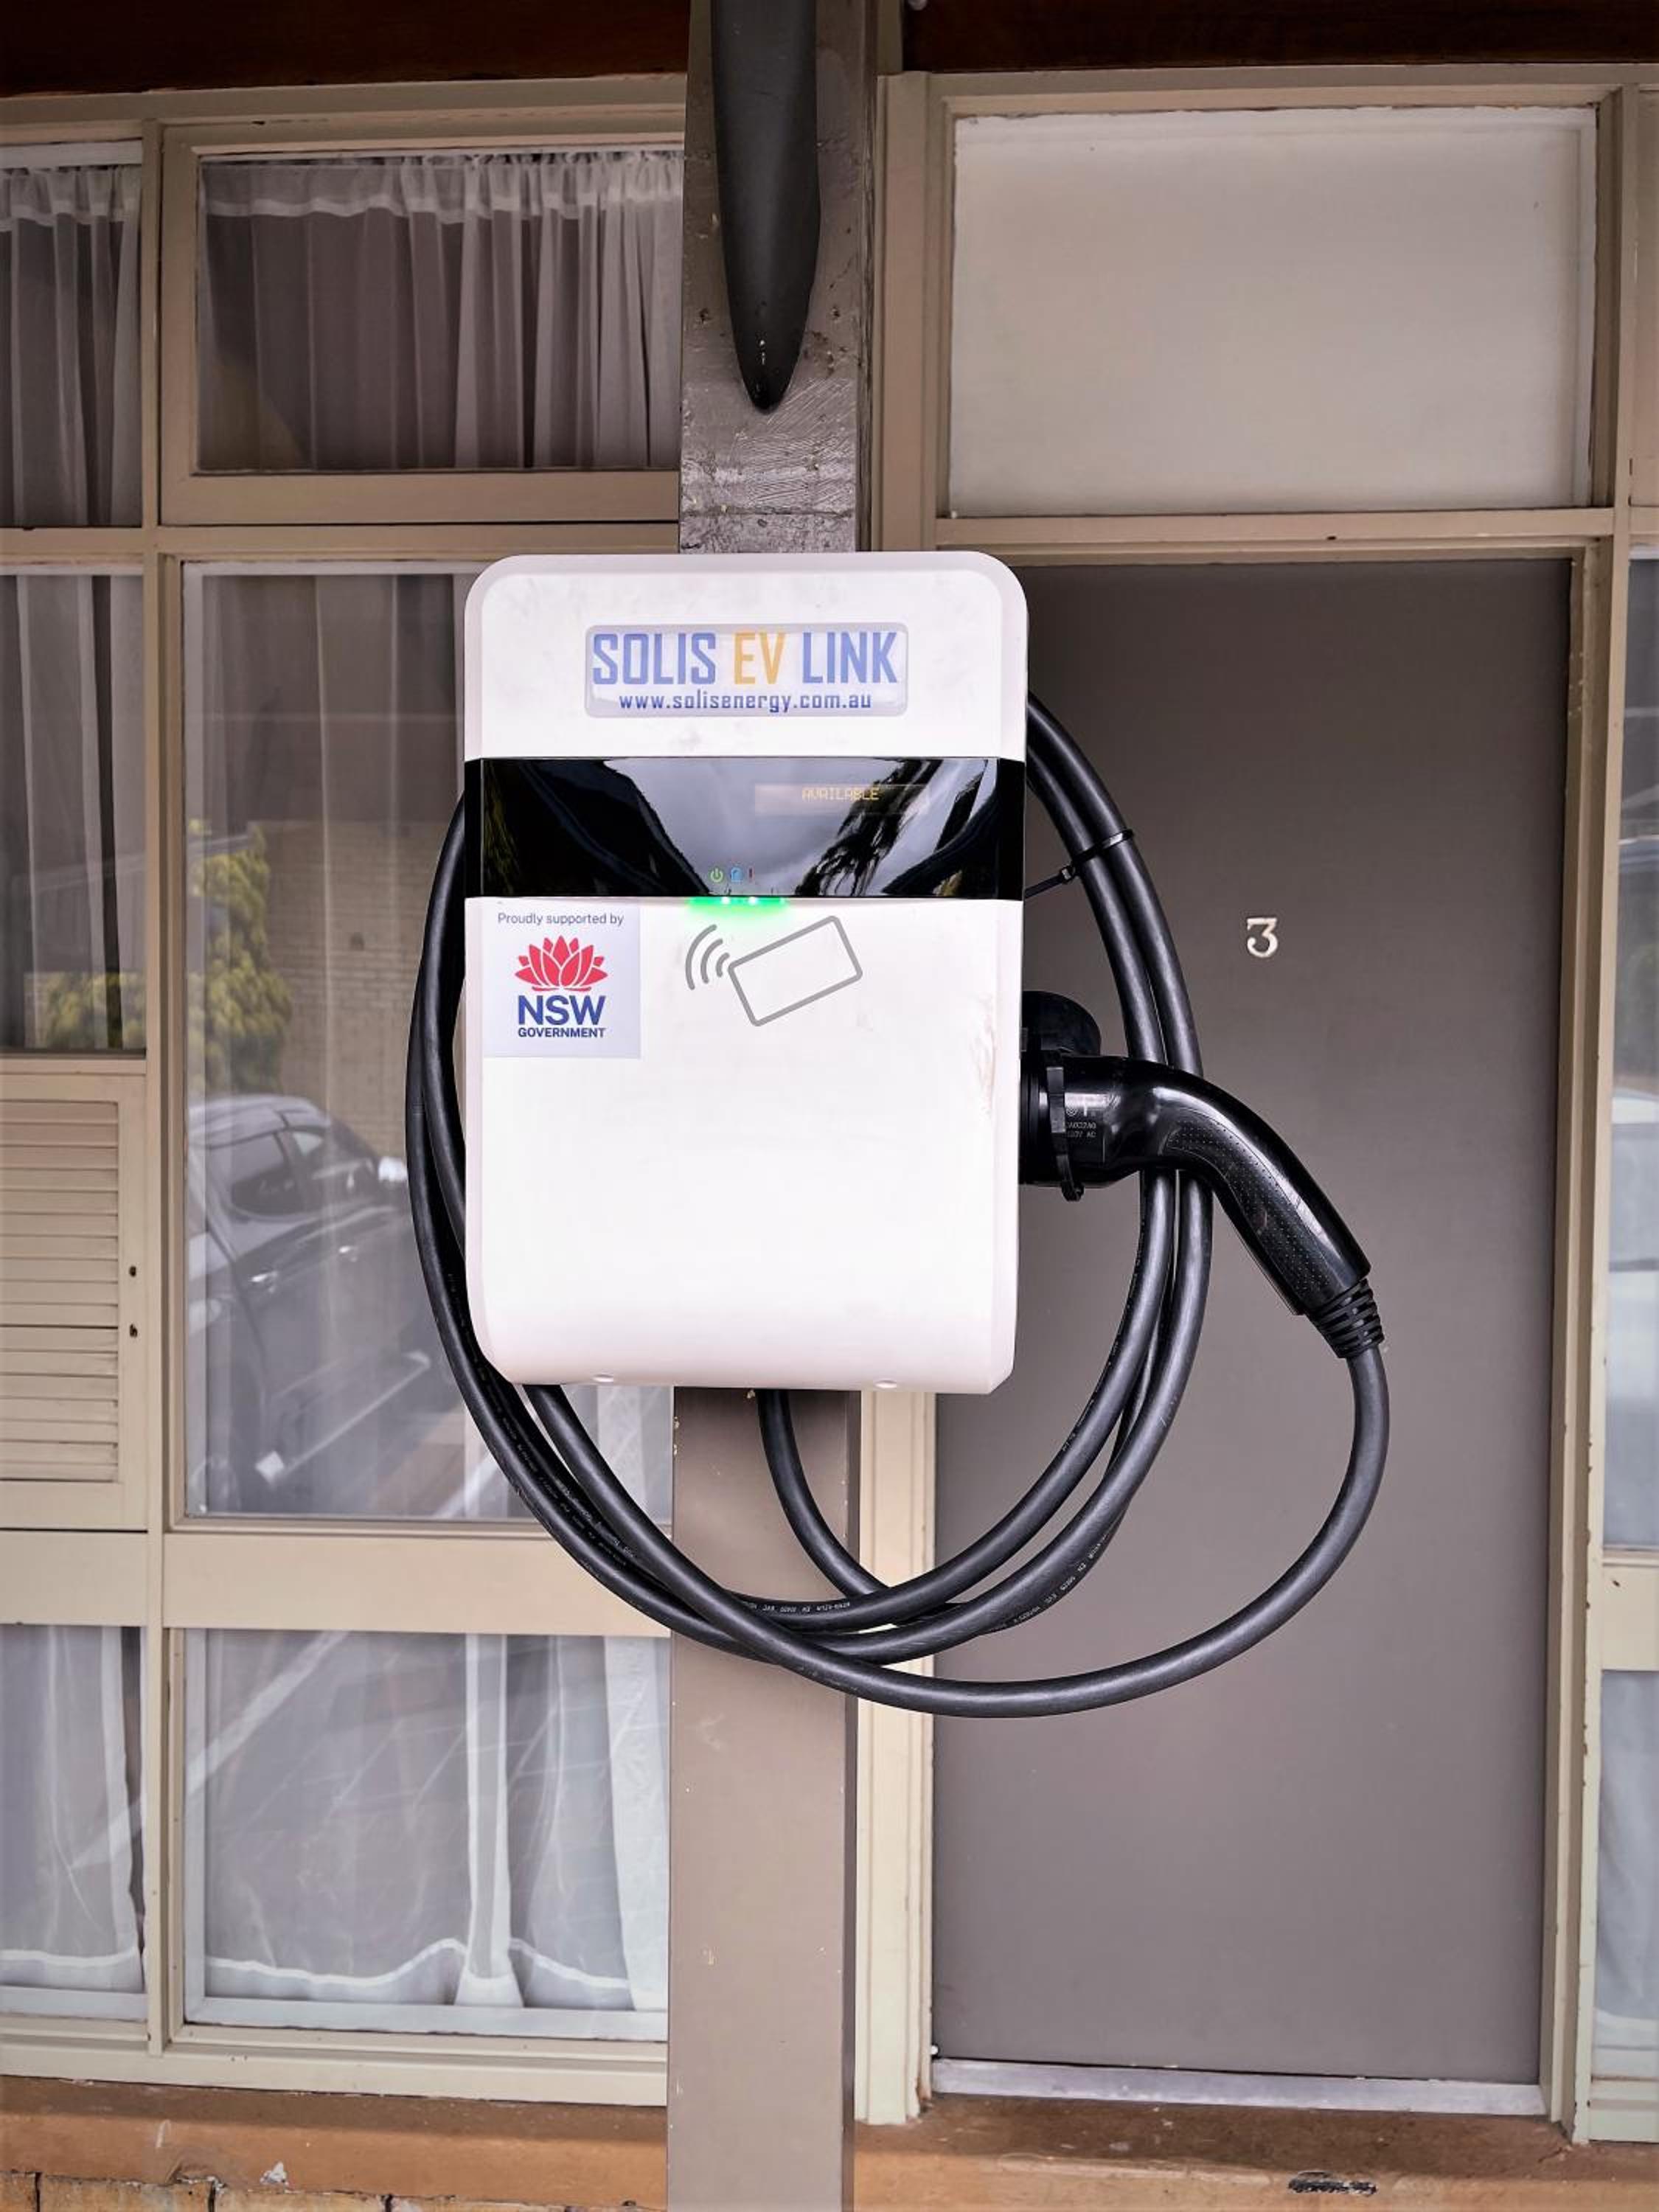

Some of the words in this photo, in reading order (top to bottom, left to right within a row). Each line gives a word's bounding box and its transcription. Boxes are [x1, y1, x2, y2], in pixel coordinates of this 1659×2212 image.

[592, 633, 716, 685] SOLIS
[733, 631, 786, 685] EV
[802, 631, 897, 684] LINK
[619, 689, 872, 713] www.solisenergy.com.au
[801, 786, 880, 801] AVAILABLE
[498, 912, 543, 925] Proudly
[546, 912, 607, 925] supported
[610, 912, 625, 925] by
[1247, 917, 1278, 958] 3
[518, 995, 606, 1026] NSW
[518, 1027, 606, 1038] GOVERNMENT
